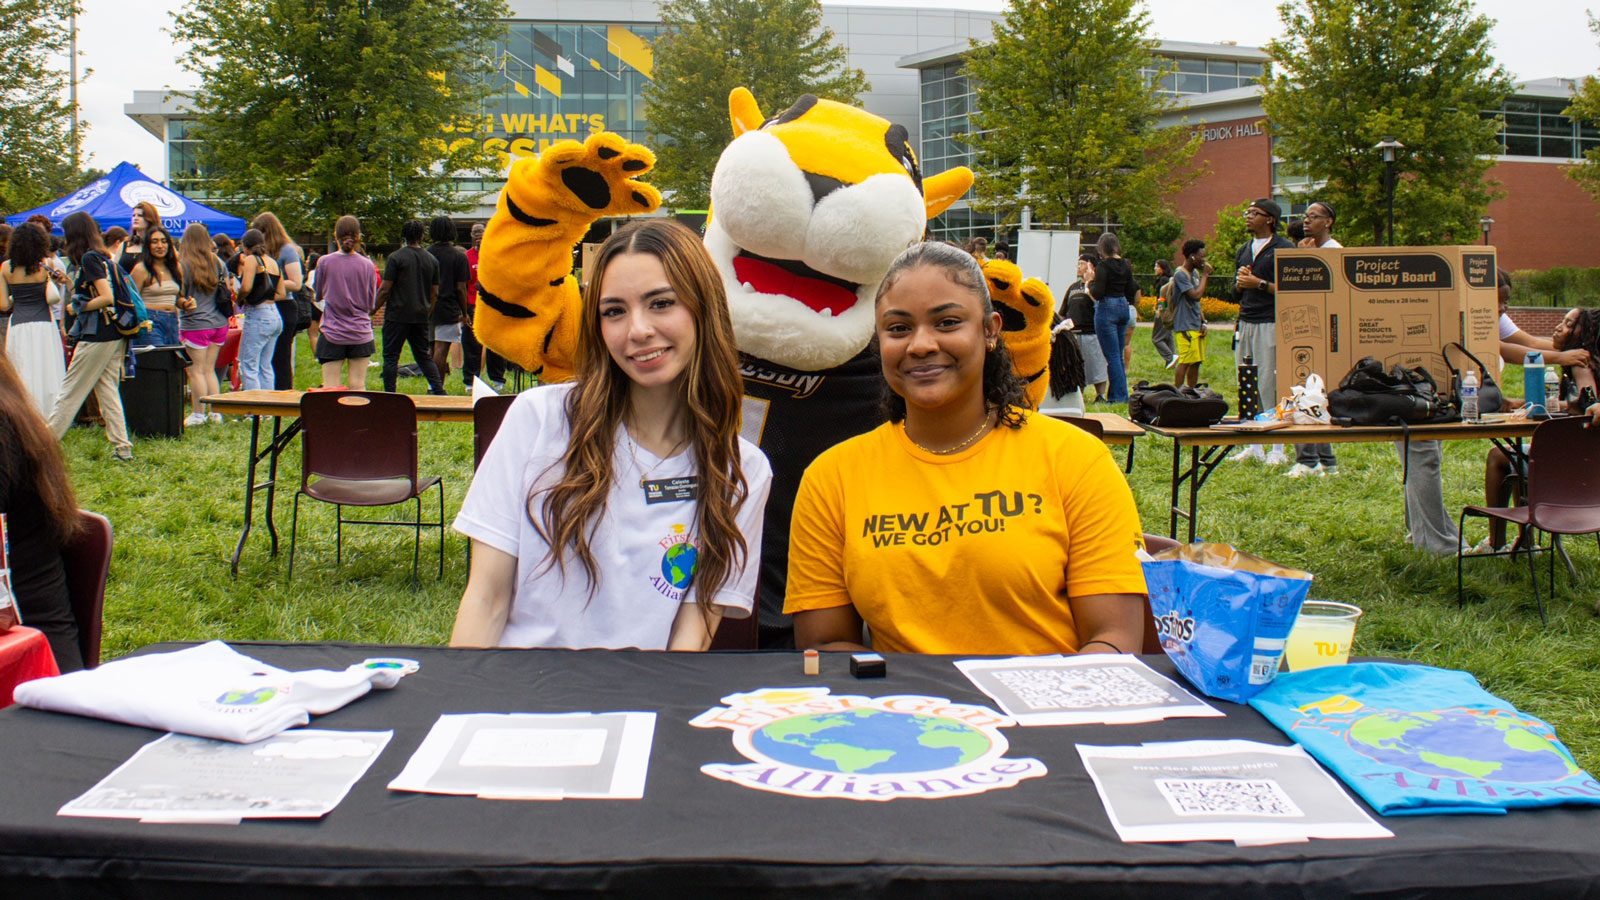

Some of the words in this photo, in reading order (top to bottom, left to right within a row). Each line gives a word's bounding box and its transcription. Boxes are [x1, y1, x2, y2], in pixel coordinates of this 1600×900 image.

[501, 113, 606, 134] WHAT'S
[1236, 123, 1262, 137] HALL
[1283, 266, 1304, 275] Bring
[1305, 267, 1323, 275] your
[1356, 258, 1400, 273] Project
[1355, 273, 1399, 286] Display
[1402, 271, 1436, 283] Board
[648, 484, 660, 492] TU
[862, 512, 930, 538] NEW
[935, 503, 970, 530] AT
[872, 532, 906, 548] WE
[912, 527, 951, 546] GOT
[954, 518, 1005, 537] YOU!
[1313, 641, 1338, 657] TU
[705, 697, 853, 728] First
[883, 697, 1011, 728] Gen
[1132, 764, 1159, 772] First
[1191, 763, 1240, 772] Alliance
[711, 758, 1033, 796] Alliance
